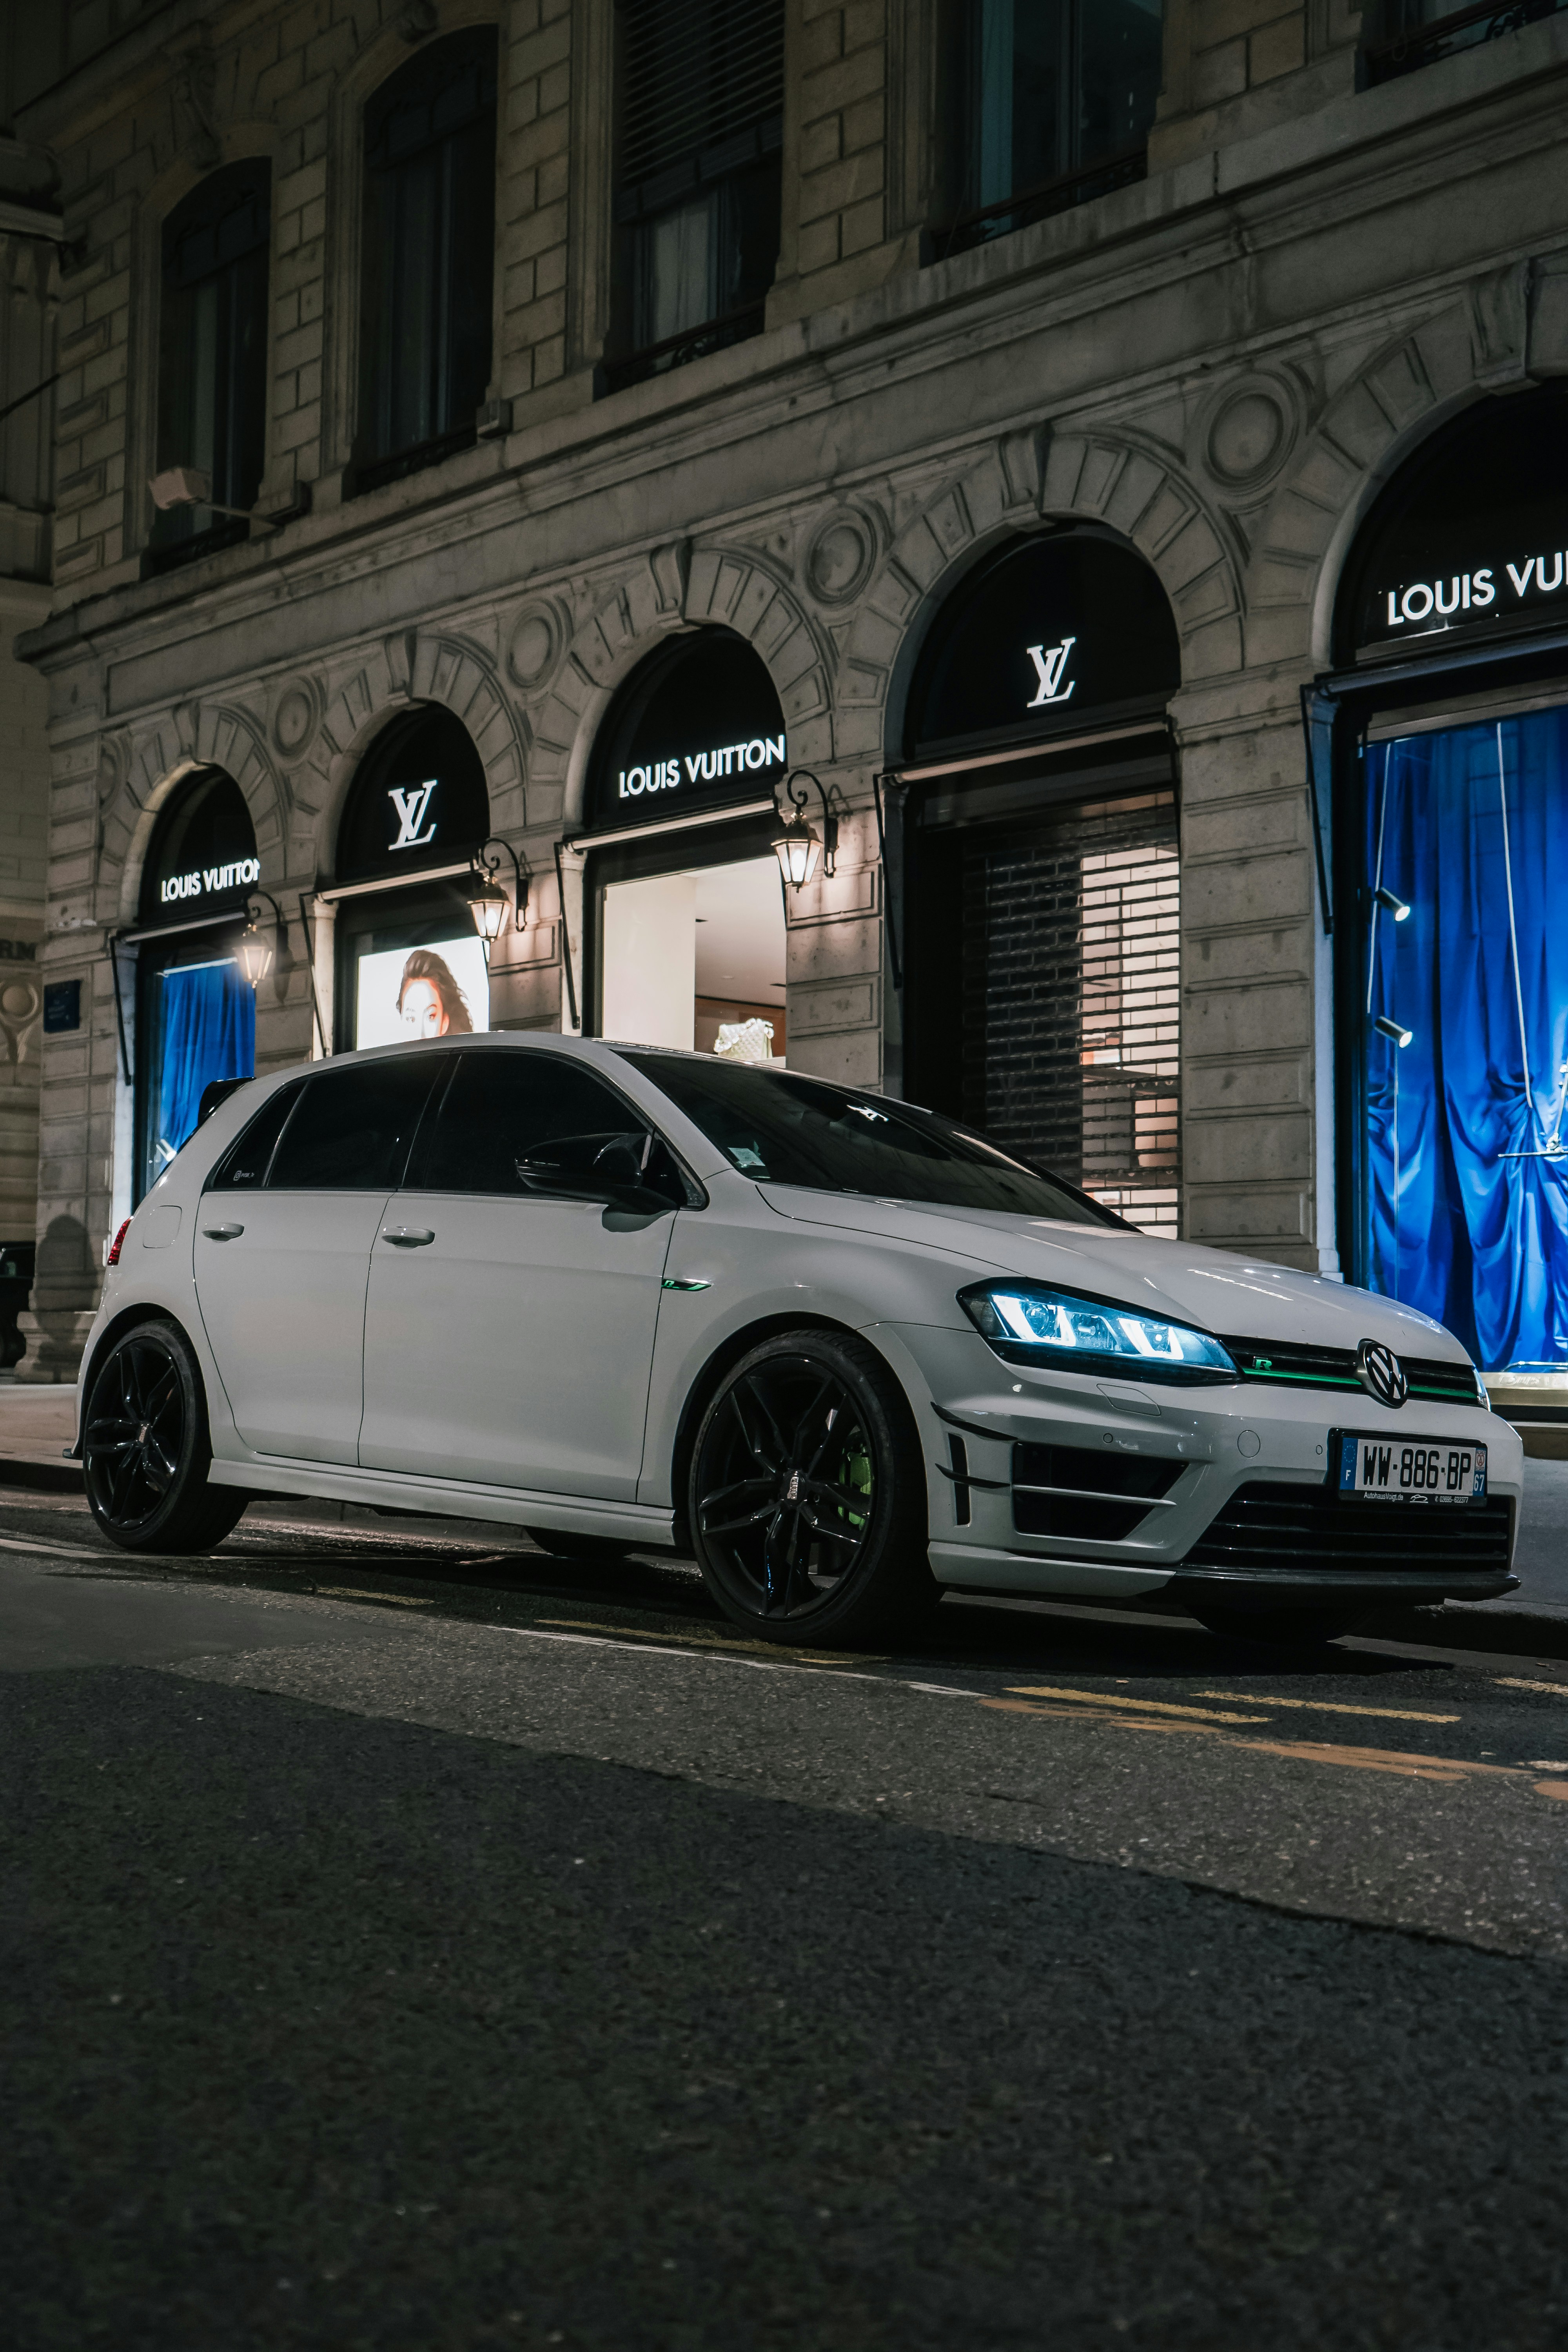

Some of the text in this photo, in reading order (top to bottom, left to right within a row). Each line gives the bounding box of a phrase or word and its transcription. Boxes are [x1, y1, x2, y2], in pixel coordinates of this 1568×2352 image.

[1388, 569, 1495, 626] LOUIS
[1026, 637, 1076, 708] LV
[619, 734, 785, 798] LOUIS VUITTON
[388, 779, 437, 851] LV
[161, 871, 201, 902] LOUIS
[1253, 1357, 1272, 1371] R
[1345, 1470, 1351, 1481] F
[1474, 1474, 1485, 1491] 67
